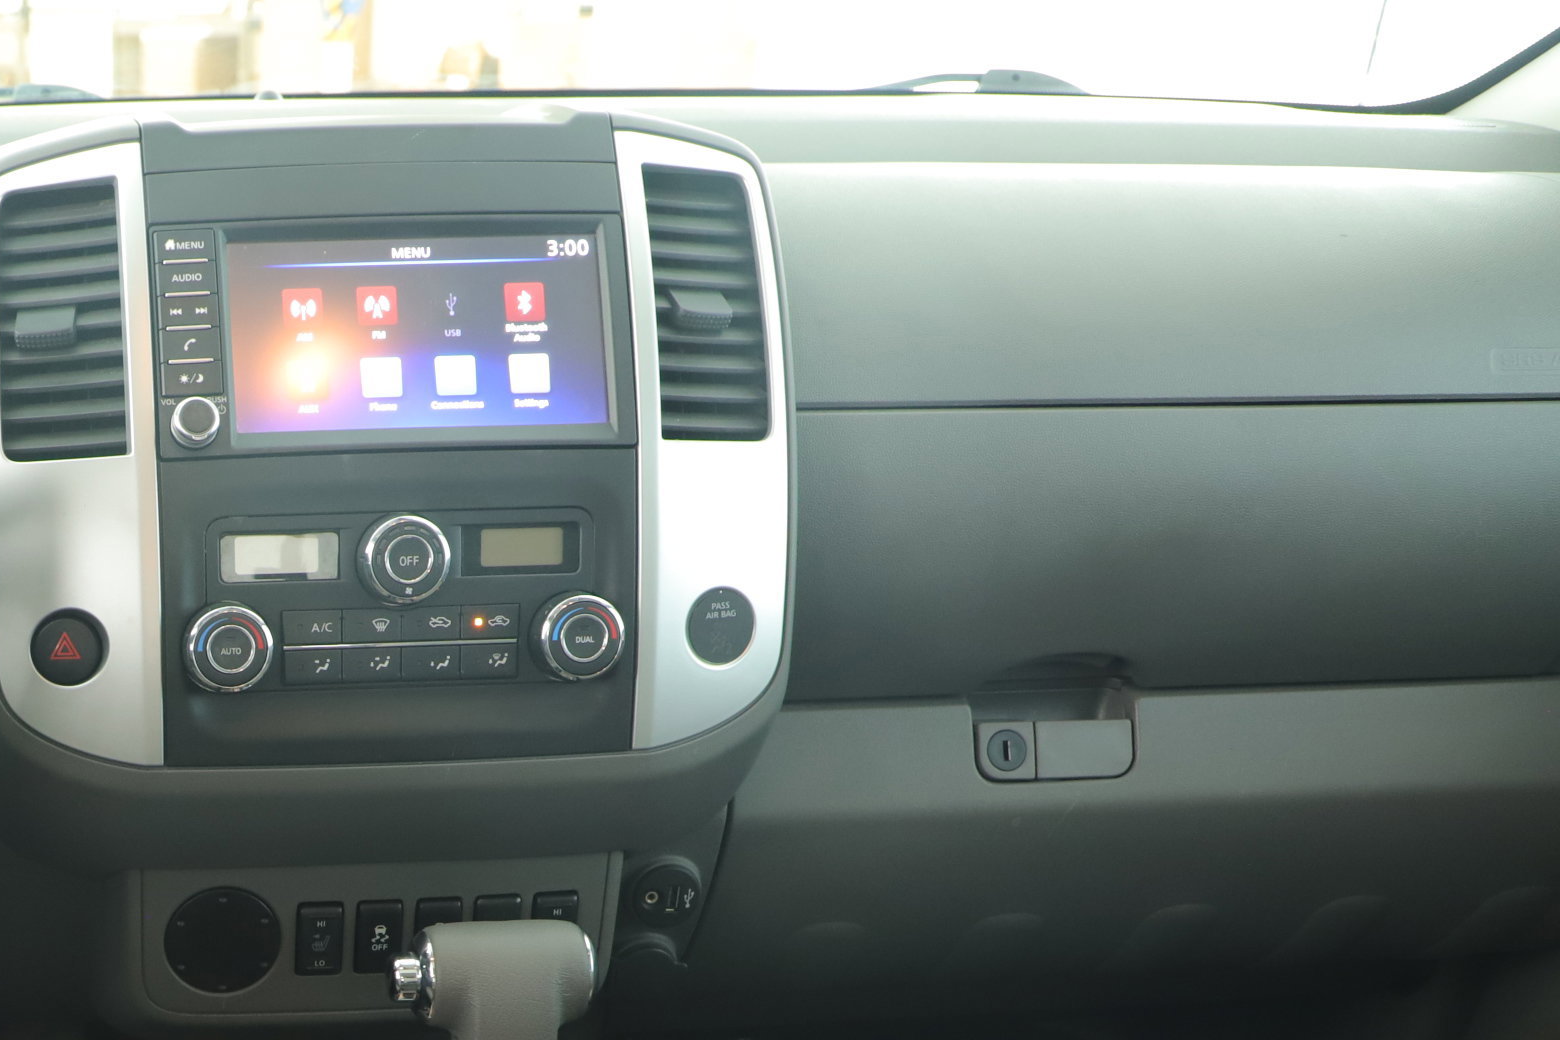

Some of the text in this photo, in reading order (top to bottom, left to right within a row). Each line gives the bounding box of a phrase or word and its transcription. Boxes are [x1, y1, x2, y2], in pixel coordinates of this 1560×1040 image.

[176, 241, 205, 250] MENU
[547, 238, 590, 257] 3:00
[391, 246, 431, 259] MENU
[172, 273, 202, 282] AUDIO
[444, 329, 462, 337] USB
[400, 555, 420, 567] OFF
[711, 601, 731, 610] PASS
[705, 609, 737, 619] AIR BAG
[311, 622, 333, 633] A/C
[575, 636, 595, 644] DUAL
[220, 647, 242, 655] AUTO
[316, 920, 327, 928] HI
[371, 943, 388, 952] OFF
[314, 959, 326, 967] LO
